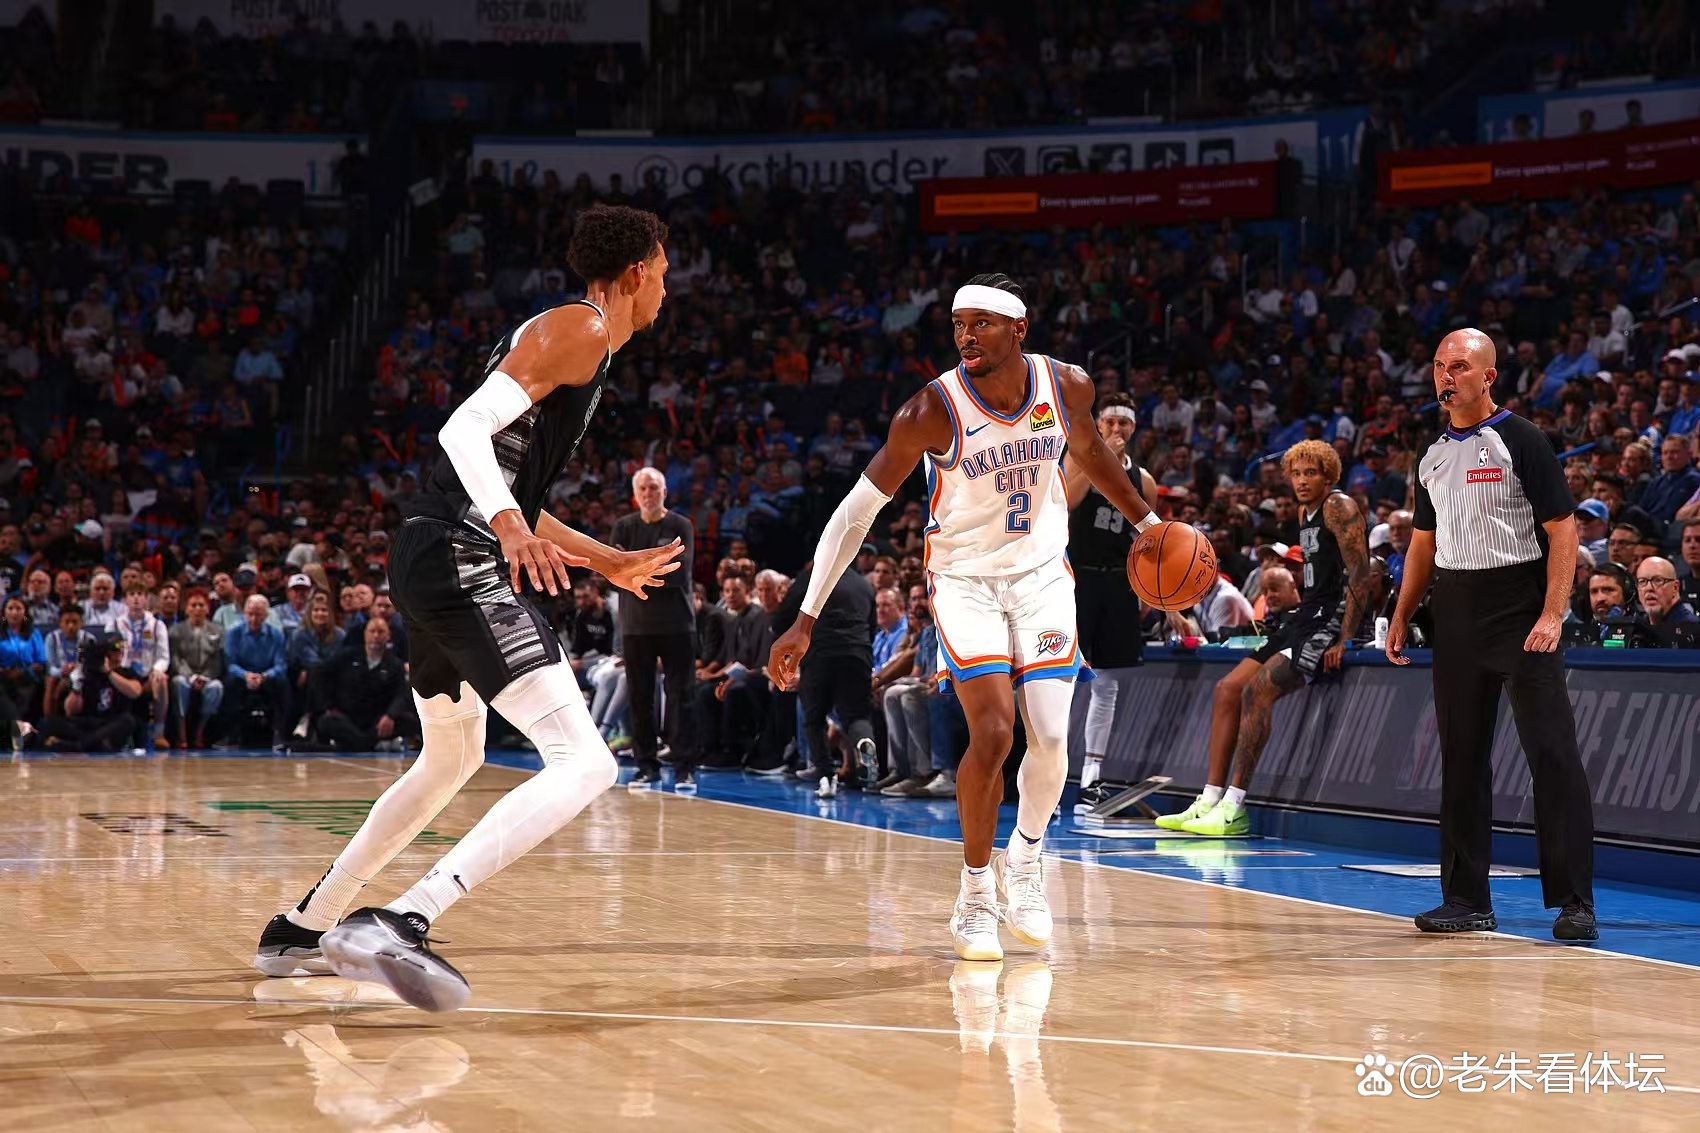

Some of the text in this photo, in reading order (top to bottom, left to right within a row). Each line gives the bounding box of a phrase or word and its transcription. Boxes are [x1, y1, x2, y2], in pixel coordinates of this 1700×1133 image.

[476, 0, 587, 23] POST OAK
[995, 464, 1040, 493] CITY
[1467, 471, 1502, 481] Emirates
[1005, 490, 1032, 534] 2
[1094, 506, 1124, 534] 23
[1594, 692, 1700, 812] FANS
